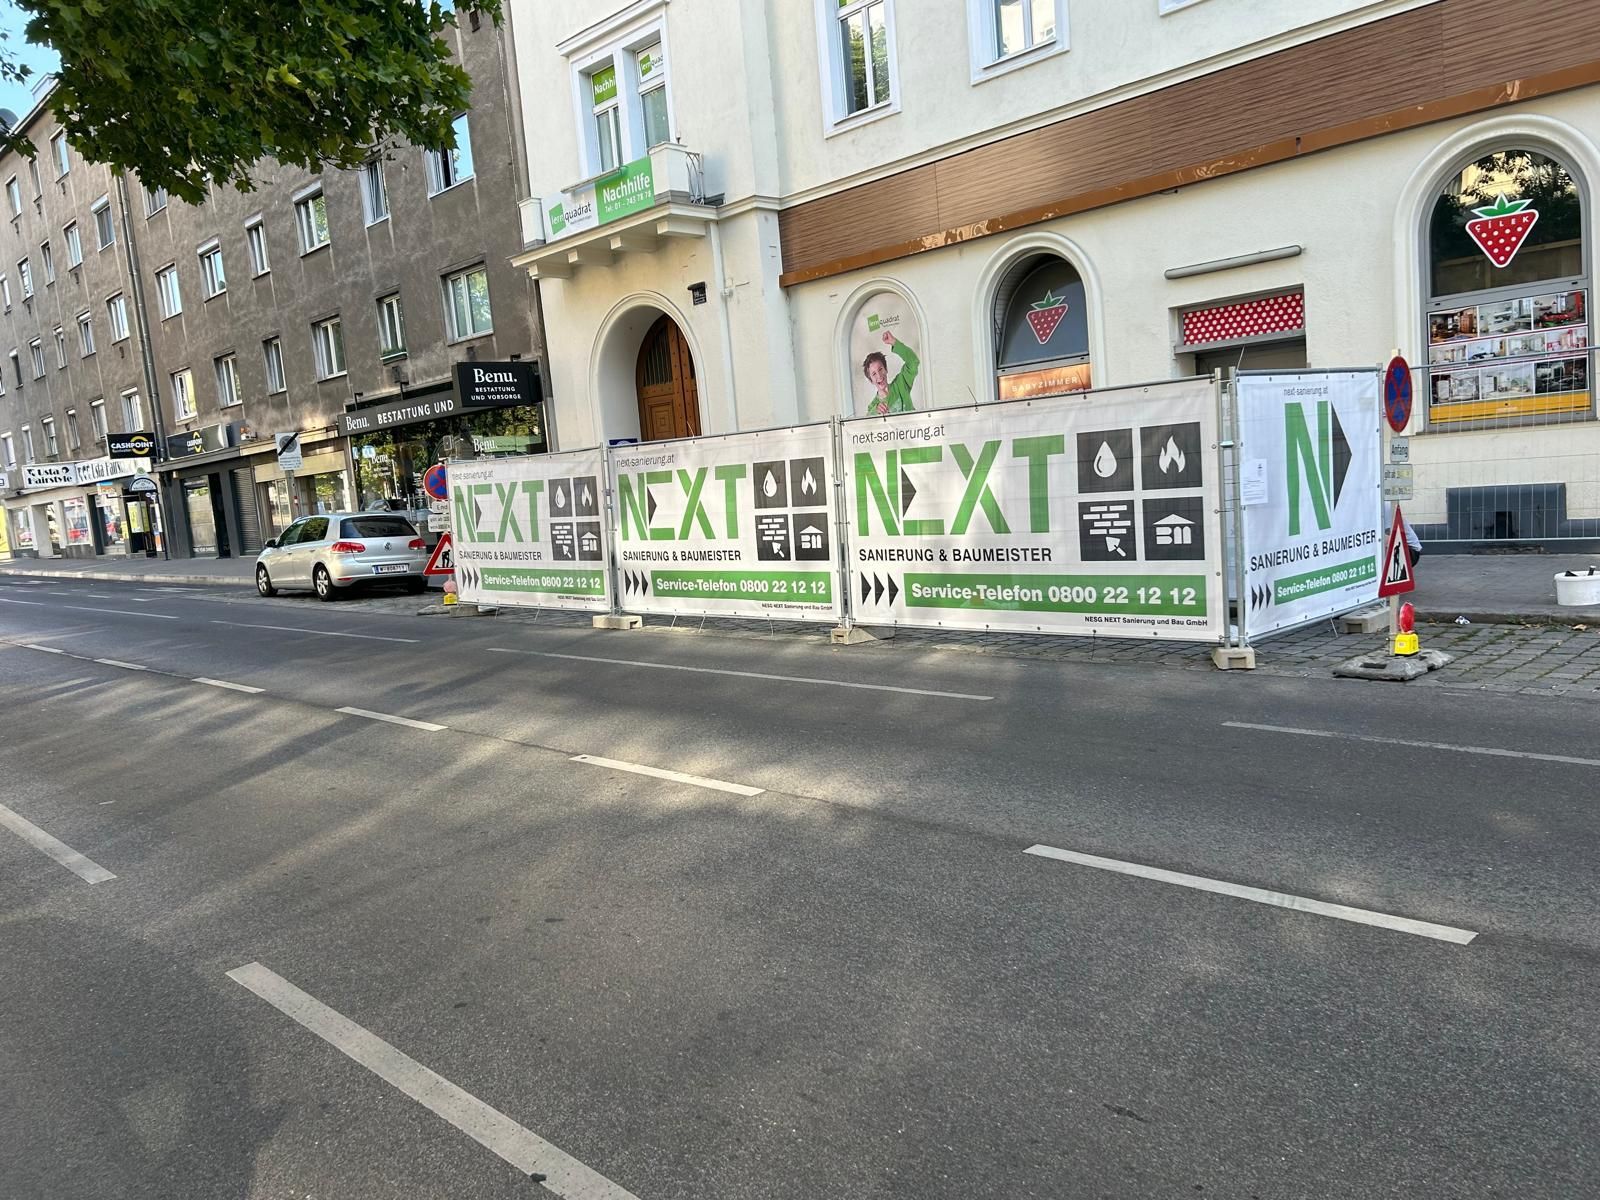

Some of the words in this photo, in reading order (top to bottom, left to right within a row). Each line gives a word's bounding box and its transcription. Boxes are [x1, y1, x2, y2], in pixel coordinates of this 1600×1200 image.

[603, 173, 650, 204] Nachhilfe
[473, 368, 518, 383] Benu.
[345, 415, 370, 431] Benu.
[377, 406, 431, 425] BESTATTUNG
[434, 399, 454, 414] UND
[852, 424, 945, 445] next-sanierung.at
[110, 441, 154, 449] CASHPOINT
[616, 454, 675, 468] next-sanierung.at
[854, 434, 1065, 537] NEXT
[453, 479, 544, 543] NEXT
[617, 463, 747, 541] NEXT
[459, 551, 493, 560] SANIERUNG
[493, 551, 499, 560] &
[499, 551, 542, 561] BAUMEISTER
[623, 550, 670, 561] SANIERUNG
[672, 551, 679, 561] &
[681, 550, 741, 561] BAUMEISTER
[859, 548, 934, 562] SANIERUNG
[939, 548, 948, 562] &
[953, 547, 1052, 562] BAUMEISTER
[1250, 545, 1310, 571] SANIERUNG
[1312, 543, 1319, 557] &
[1322, 529, 1376, 555] BAUMEISTER
[484, 574, 540, 587] Service-Telefon
[541, 577, 562, 588] 0800
[563, 577, 574, 588] 22
[576, 577, 587, 588] 12
[589, 577, 600, 589] 12
[656, 578, 737, 592] Service-Telefon
[740, 580, 769, 592] 0800
[772, 580, 787, 593] 22
[791, 581, 807, 593] 12
[810, 581, 826, 594] 12
[1277, 576, 1331, 597] Service-Telefon
[1332, 571, 1347, 583] 0800
[1348, 567, 1357, 577] 22
[1358, 565, 1366, 576] 12
[1367, 562, 1375, 573] 12
[912, 583, 1043, 602] Service-Telefon
[1048, 586, 1097, 603] 0800
[1103, 586, 1129, 604] 22
[1137, 587, 1162, 605] 12
[1170, 587, 1196, 605] 12
[1122, 617, 1155, 625] Sanierung
